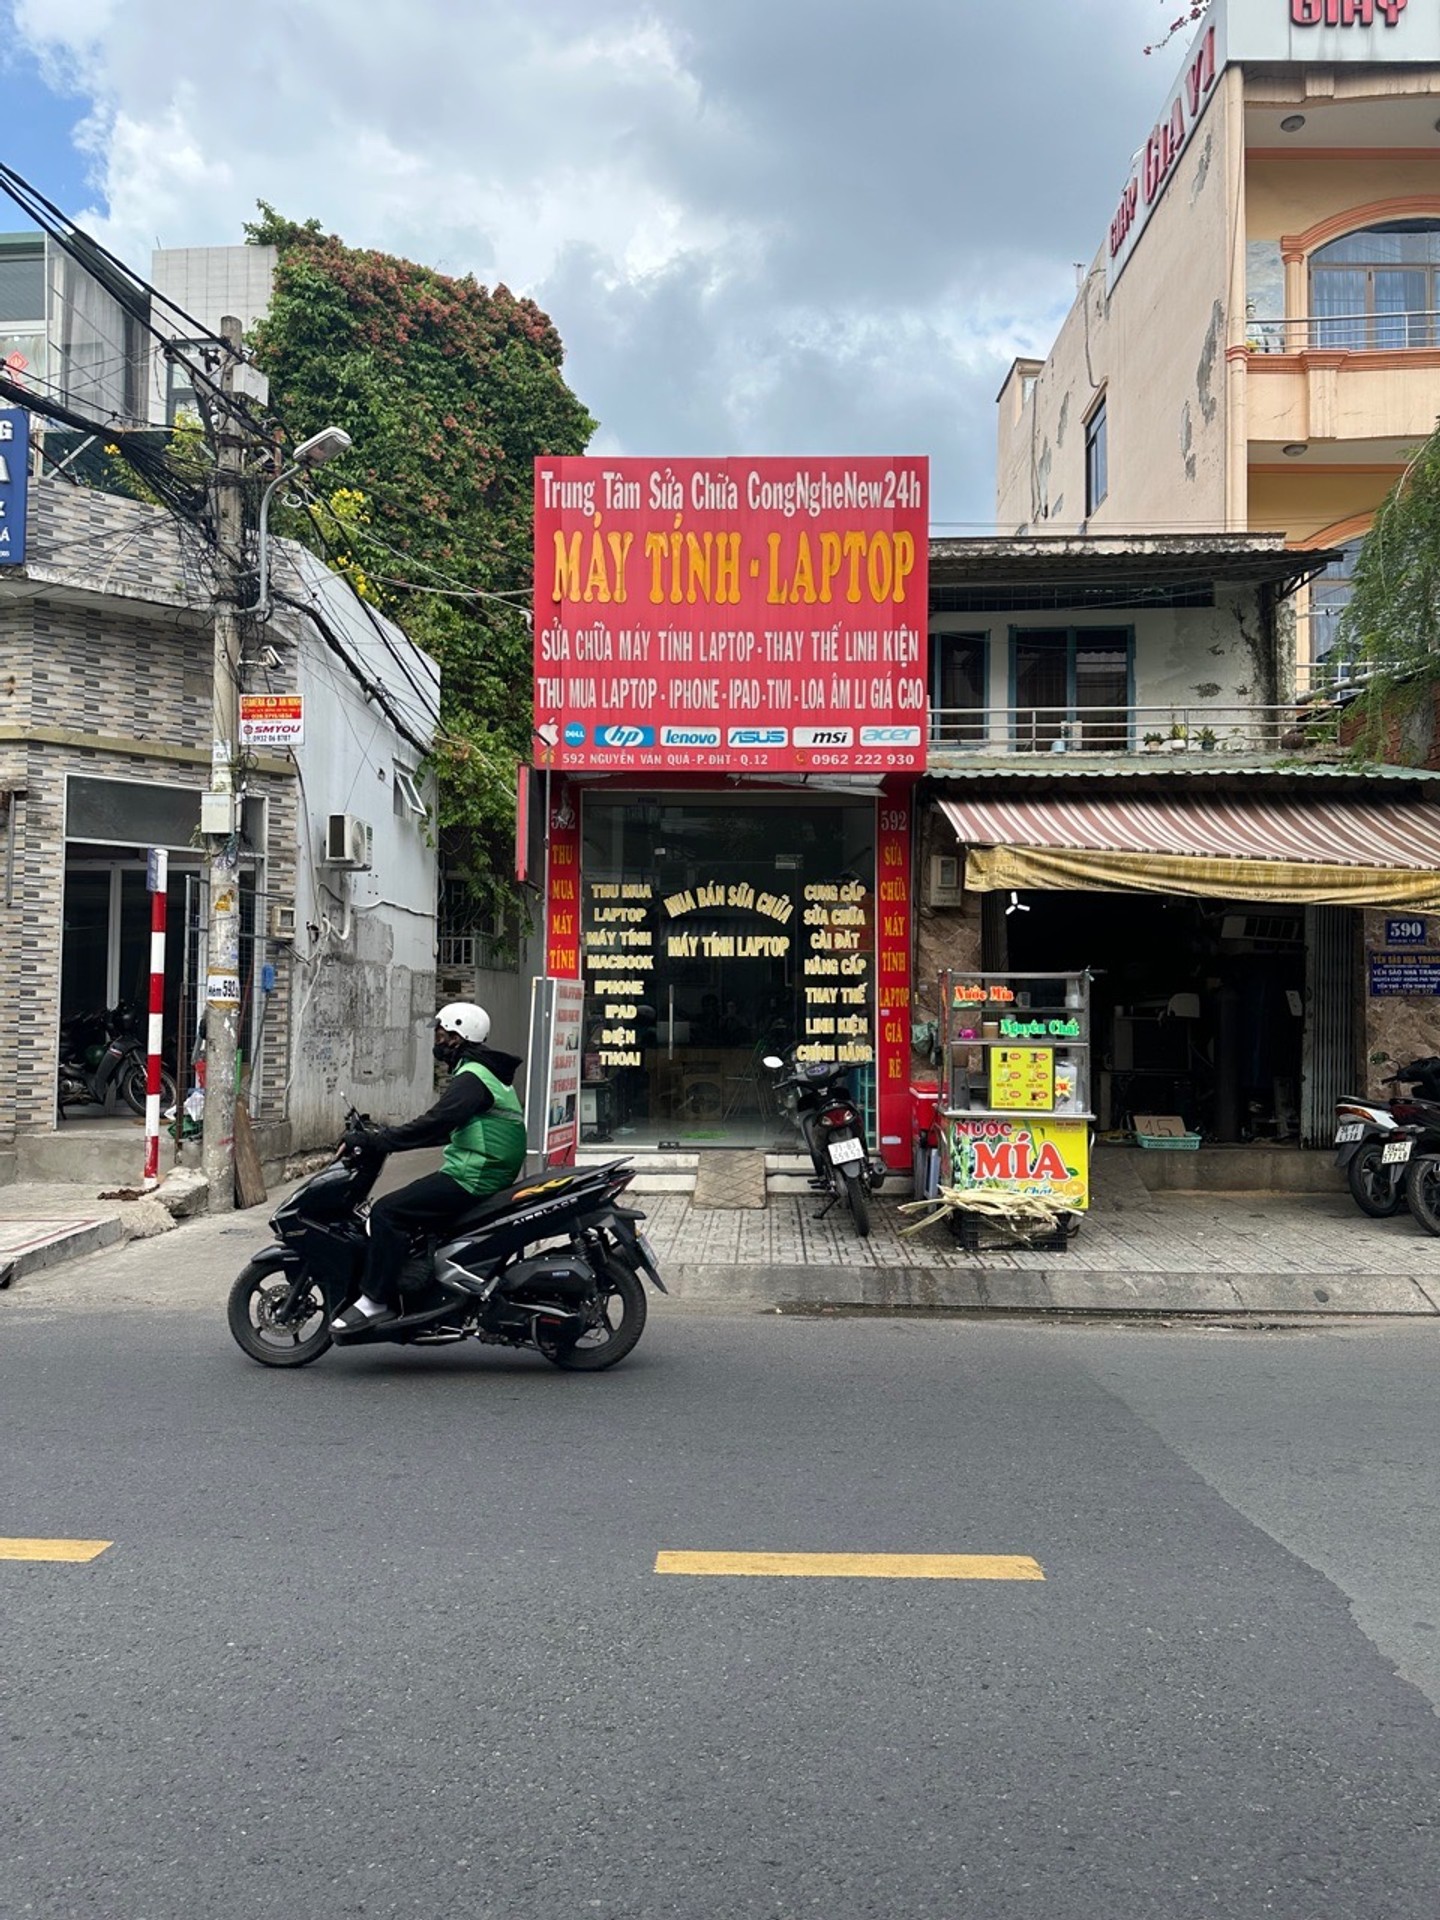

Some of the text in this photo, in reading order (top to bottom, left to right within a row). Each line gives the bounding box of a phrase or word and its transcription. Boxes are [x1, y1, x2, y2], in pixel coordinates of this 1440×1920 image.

[541, 468, 921, 517] Trung Tâm Sửa Chữa CongNgheNew24h
[552, 511, 633, 603] MÁY
[645, 512, 742, 604] TÍNH
[767, 530, 915, 604] LAPTOP
[541, 617, 570, 661] SỬA
[575, 621, 613, 661] CHỮA
[619, 622, 650, 661] MÁY
[658, 623, 693, 661] TÍNH
[811, 621, 842, 661] THẾ
[845, 631, 878, 661] LINH
[883, 623, 918, 668] KIỆN
[537, 678, 565, 708] THU
[569, 678, 597, 708] MUA
[602, 678, 657, 709] LAPTOP
[830, 672, 850, 709] ÂM
[855, 679, 866, 709] LI
[871, 671, 893, 709] GIÁ
[898, 678, 923, 709] CAO
[565, 727, 918, 749] DELL hp lenovo ASUS msi acer
[563, 754, 584, 764] 592
[812, 755, 915, 764] 0962 222 930
[881, 810, 907, 831] 592
[552, 845, 573, 864] THU
[552, 880, 574, 900] MUA
[591, 884, 652, 898] THU MUA
[663, 890, 697, 918] MUA
[696, 880, 725, 908] BÁN
[804, 884, 838, 901] CUNG
[552, 910, 573, 934] MÁY
[594, 908, 647, 922] LAPTOP
[884, 910, 905, 937] MÁY
[586, 929, 652, 946] MÁY TÍNH
[1391, 922, 1422, 937] 590
[667, 931, 790, 957] MÁY TÍNH LAPTOP
[550, 945, 576, 969] TÍNH
[587, 955, 653, 969] MACBOOK
[882, 946, 906, 972] TÍNH
[594, 981, 644, 995] IPHONE
[805, 982, 868, 1004] THAY THẾ
[879, 987, 910, 1007] LAPTOP
[954, 985, 987, 1001] Nước
[605, 1004, 637, 1019] IPAD
[602, 1026, 636, 1046] ĐIỆN
[805, 1014, 868, 1037] LINH KIỆN
[885, 1017, 903, 1042] GIÁ
[1000, 1017, 1080, 1038] Nguyên Chất
[796, 1041, 836, 1061] CHÍNH
[972, 1132, 1070, 1180] MÍA
